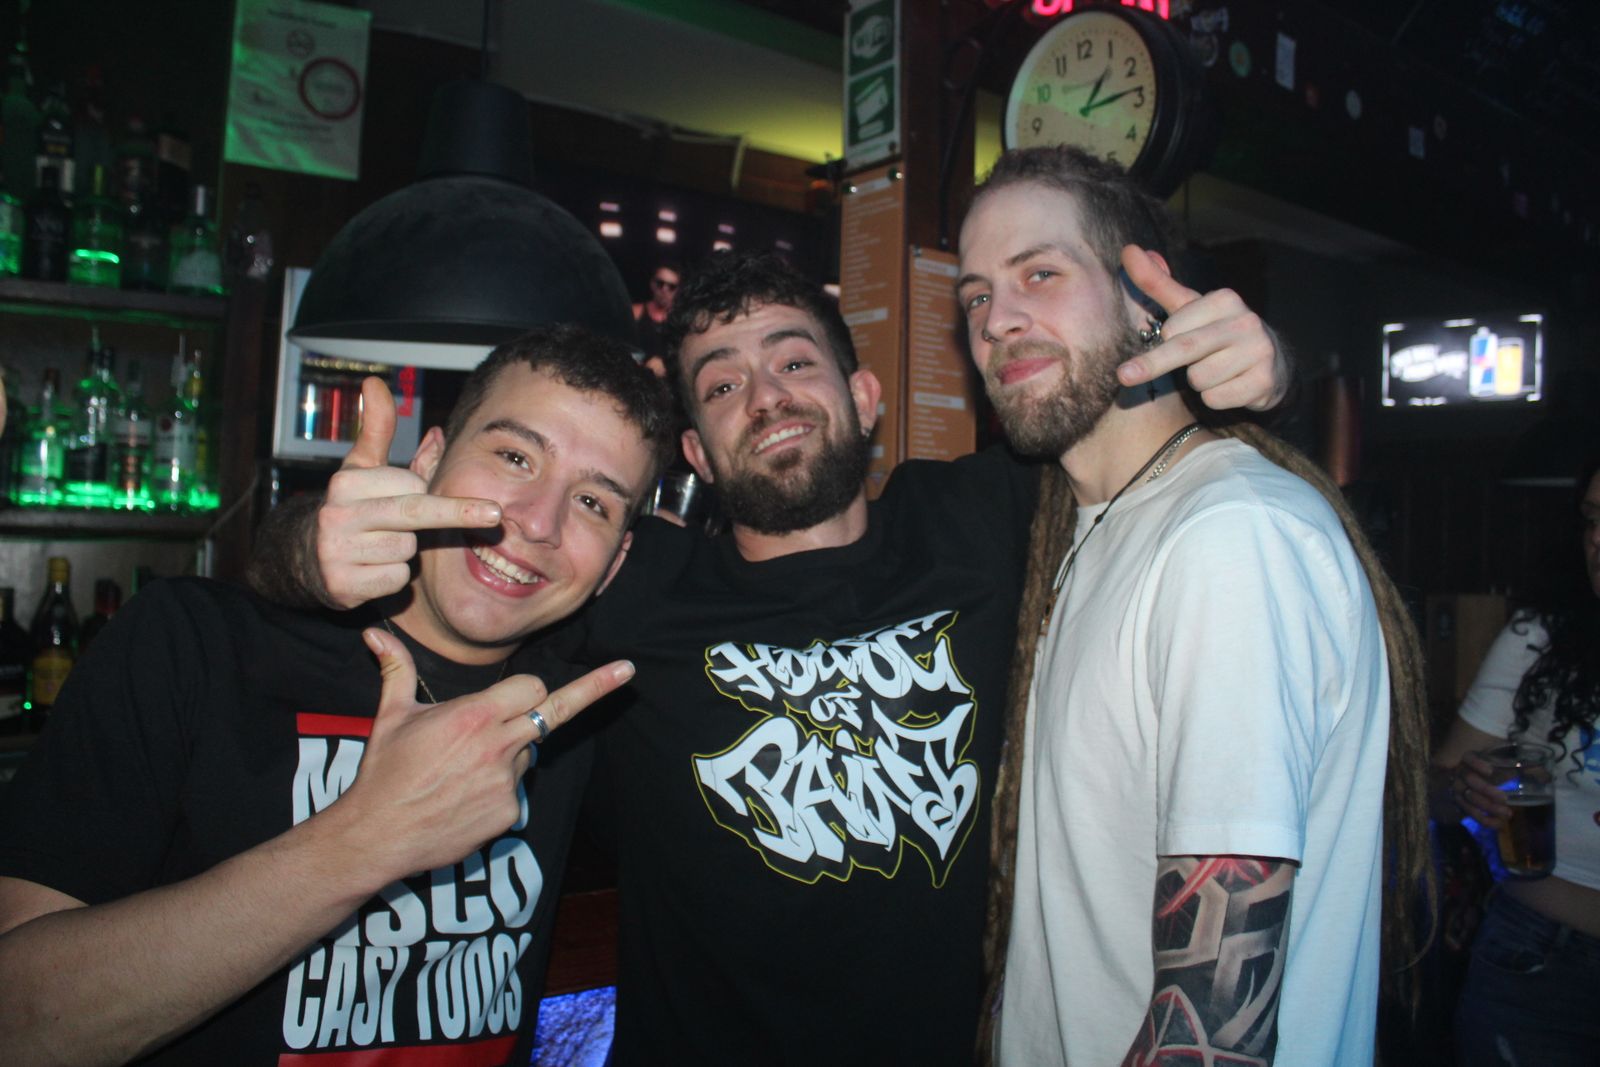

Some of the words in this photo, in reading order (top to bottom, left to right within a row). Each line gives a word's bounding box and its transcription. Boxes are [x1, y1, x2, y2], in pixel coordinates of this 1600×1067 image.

[1077, 39, 1093, 60] 12
[1108, 40, 1113, 59] 1
[1055, 55, 1067, 77] 11
[1125, 57, 1137, 78] 2
[1036, 84, 1050, 103] 10
[1133, 85, 1145, 108] 3
[1032, 117, 1042, 135] 9
[1125, 124, 1137, 141] 4
[282, 944, 410, 1049] CASI
[415, 932, 533, 1040] TODOS
